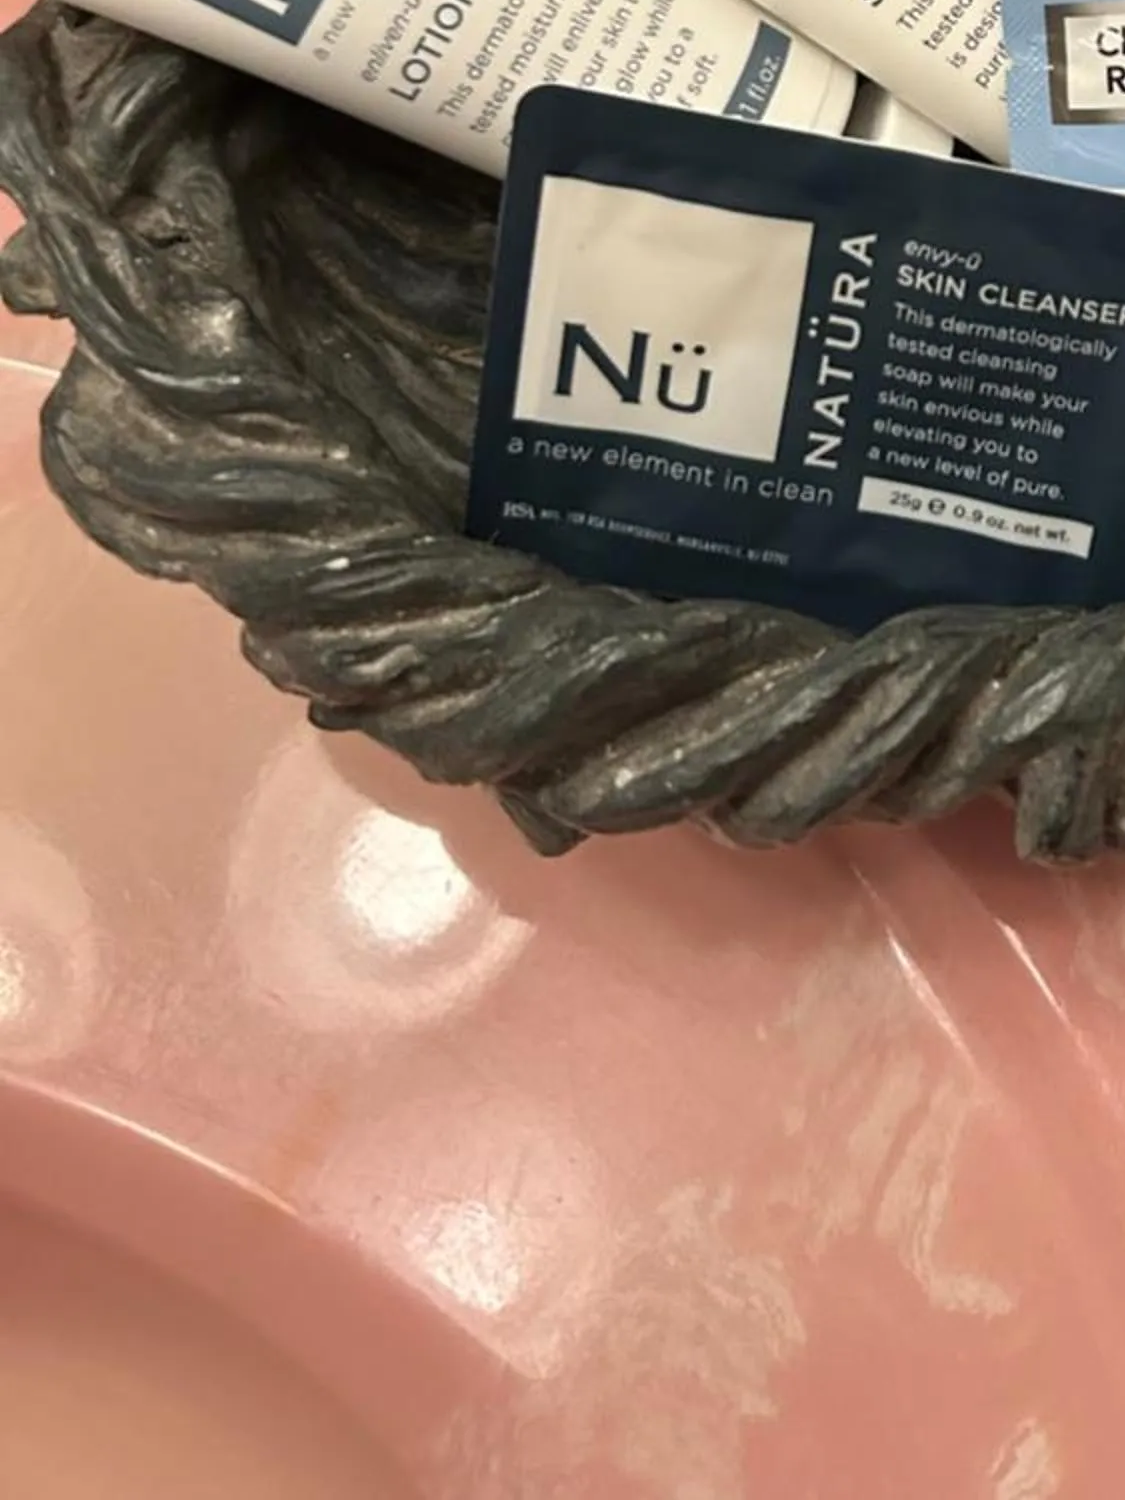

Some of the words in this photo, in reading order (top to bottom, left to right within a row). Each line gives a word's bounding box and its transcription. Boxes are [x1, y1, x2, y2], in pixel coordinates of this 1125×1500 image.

[313, 46, 331, 61] a
[322, 3, 356, 45] new
[578, 51, 608, 88] our
[602, 7, 632, 49] skin
[665, 43, 685, 68] to
[680, 27, 694, 41] a
[615, 41, 650, 94] glow
[688, 53, 719, 96] soft.
[946, 51, 967, 69] is
[436, 83, 474, 117] This
[469, 77, 516, 133] tested
[896, 264, 967, 300] SKIN
[803, 233, 879, 469] NATÜRA
[887, 332, 953, 360] tested
[958, 350, 1057, 381] cleansing
[893, 302, 934, 328] This
[940, 314, 1118, 362] dermatologically
[554, 321, 712, 414] Nü
[882, 362, 932, 387] soap
[938, 372, 974, 392] will
[979, 381, 1035, 404] make
[1040, 393, 1089, 413] your
[878, 390, 919, 411] skin
[924, 400, 1003, 427] envious
[1010, 411, 1065, 438] while
[873, 417, 967, 451] elevating
[973, 434, 1011, 457] you
[1016, 445, 1038, 465] to
[507, 435, 524, 454] a
[533, 437, 593, 463] new
[602, 445, 715, 488] element
[724, 468, 748, 493] in
[758, 476, 833, 506] clean
[867, 446, 879, 460] a
[886, 448, 930, 470] new
[935, 457, 981, 481] level
[987, 469, 1009, 487] of
[1013, 477, 1064, 500] pure.
[889, 491, 922, 511] 25g
[953, 504, 983, 524] 0.9
[1014, 521, 1040, 538] net
[1045, 528, 1071, 543] wt.
